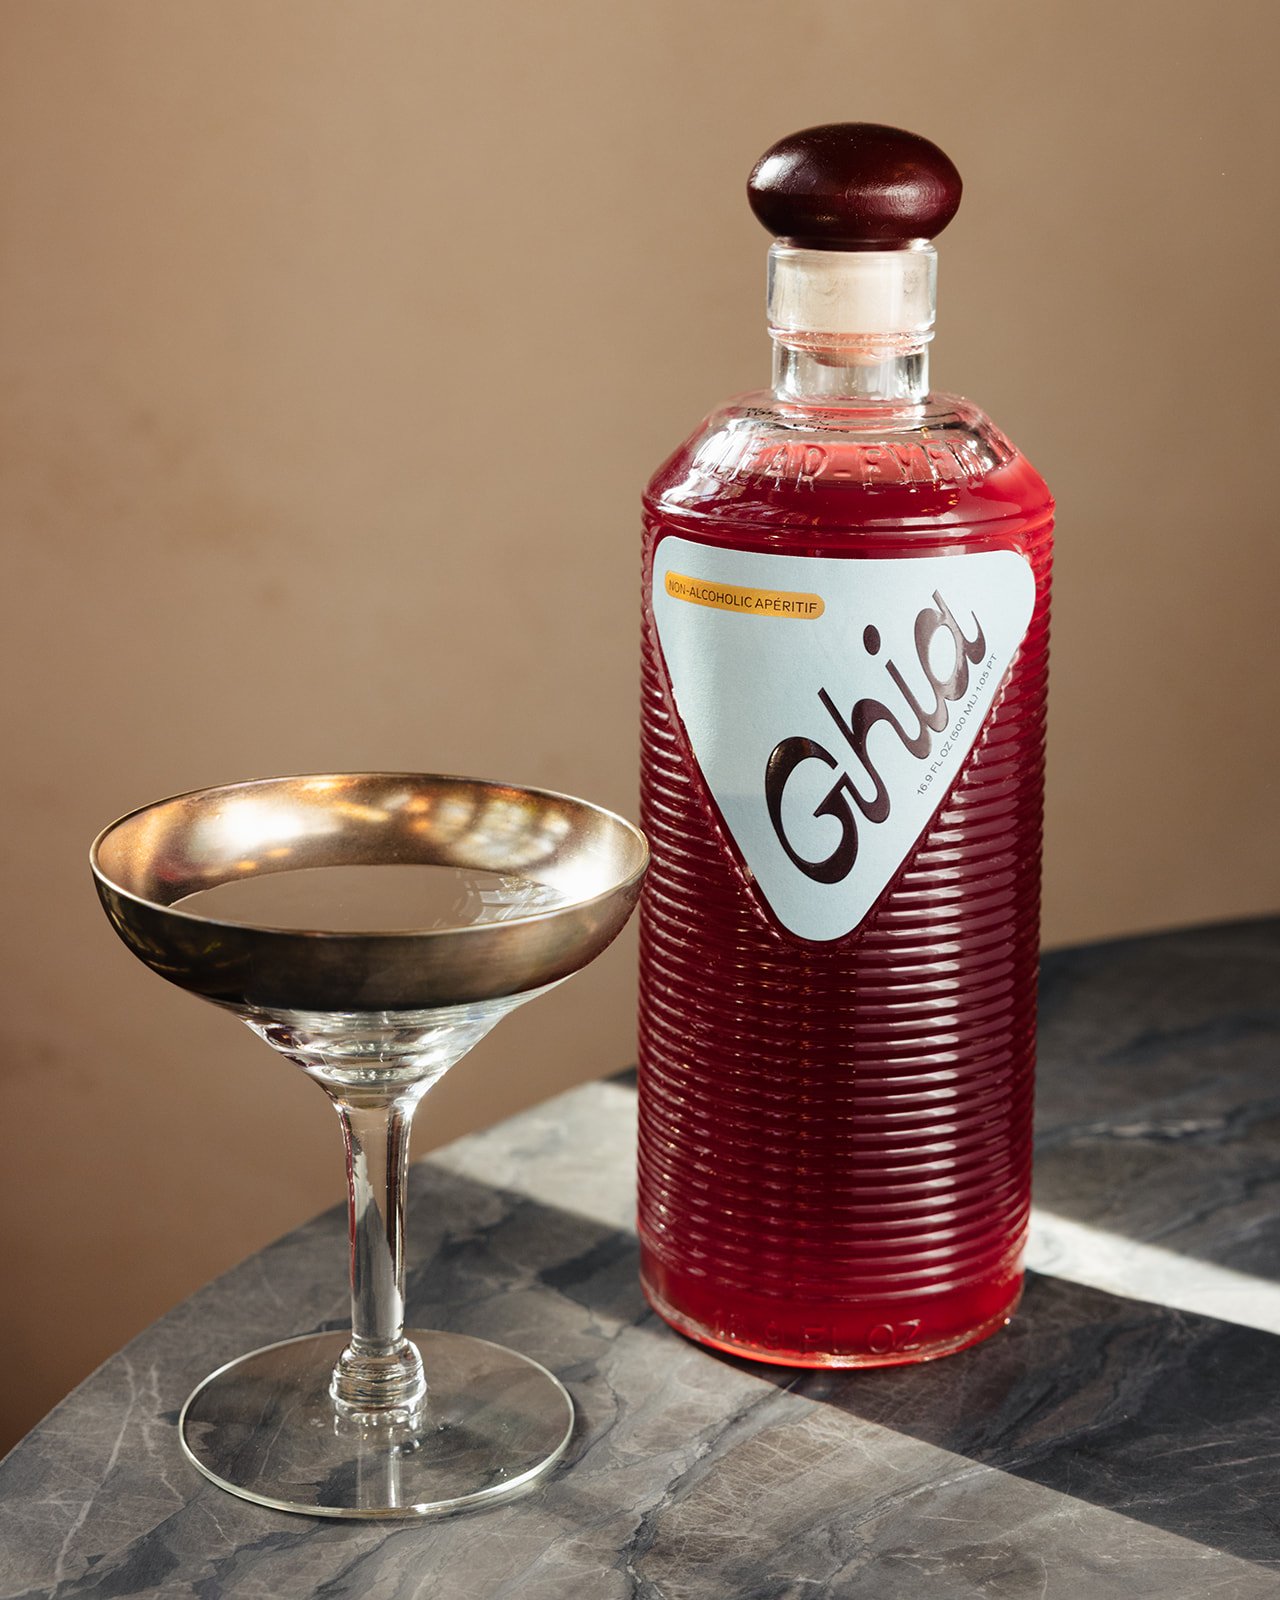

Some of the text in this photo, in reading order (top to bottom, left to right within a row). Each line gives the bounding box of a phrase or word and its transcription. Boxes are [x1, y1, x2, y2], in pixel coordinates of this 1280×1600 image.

[668, 579, 818, 613] NON-ALCOHOLIC APÉRITIF
[764, 589, 987, 885] Ghia
[916, 652, 998, 796] 16.9 FL OZ (500 ML) 1.05 PT
[868, 1318, 923, 1354] OZ
